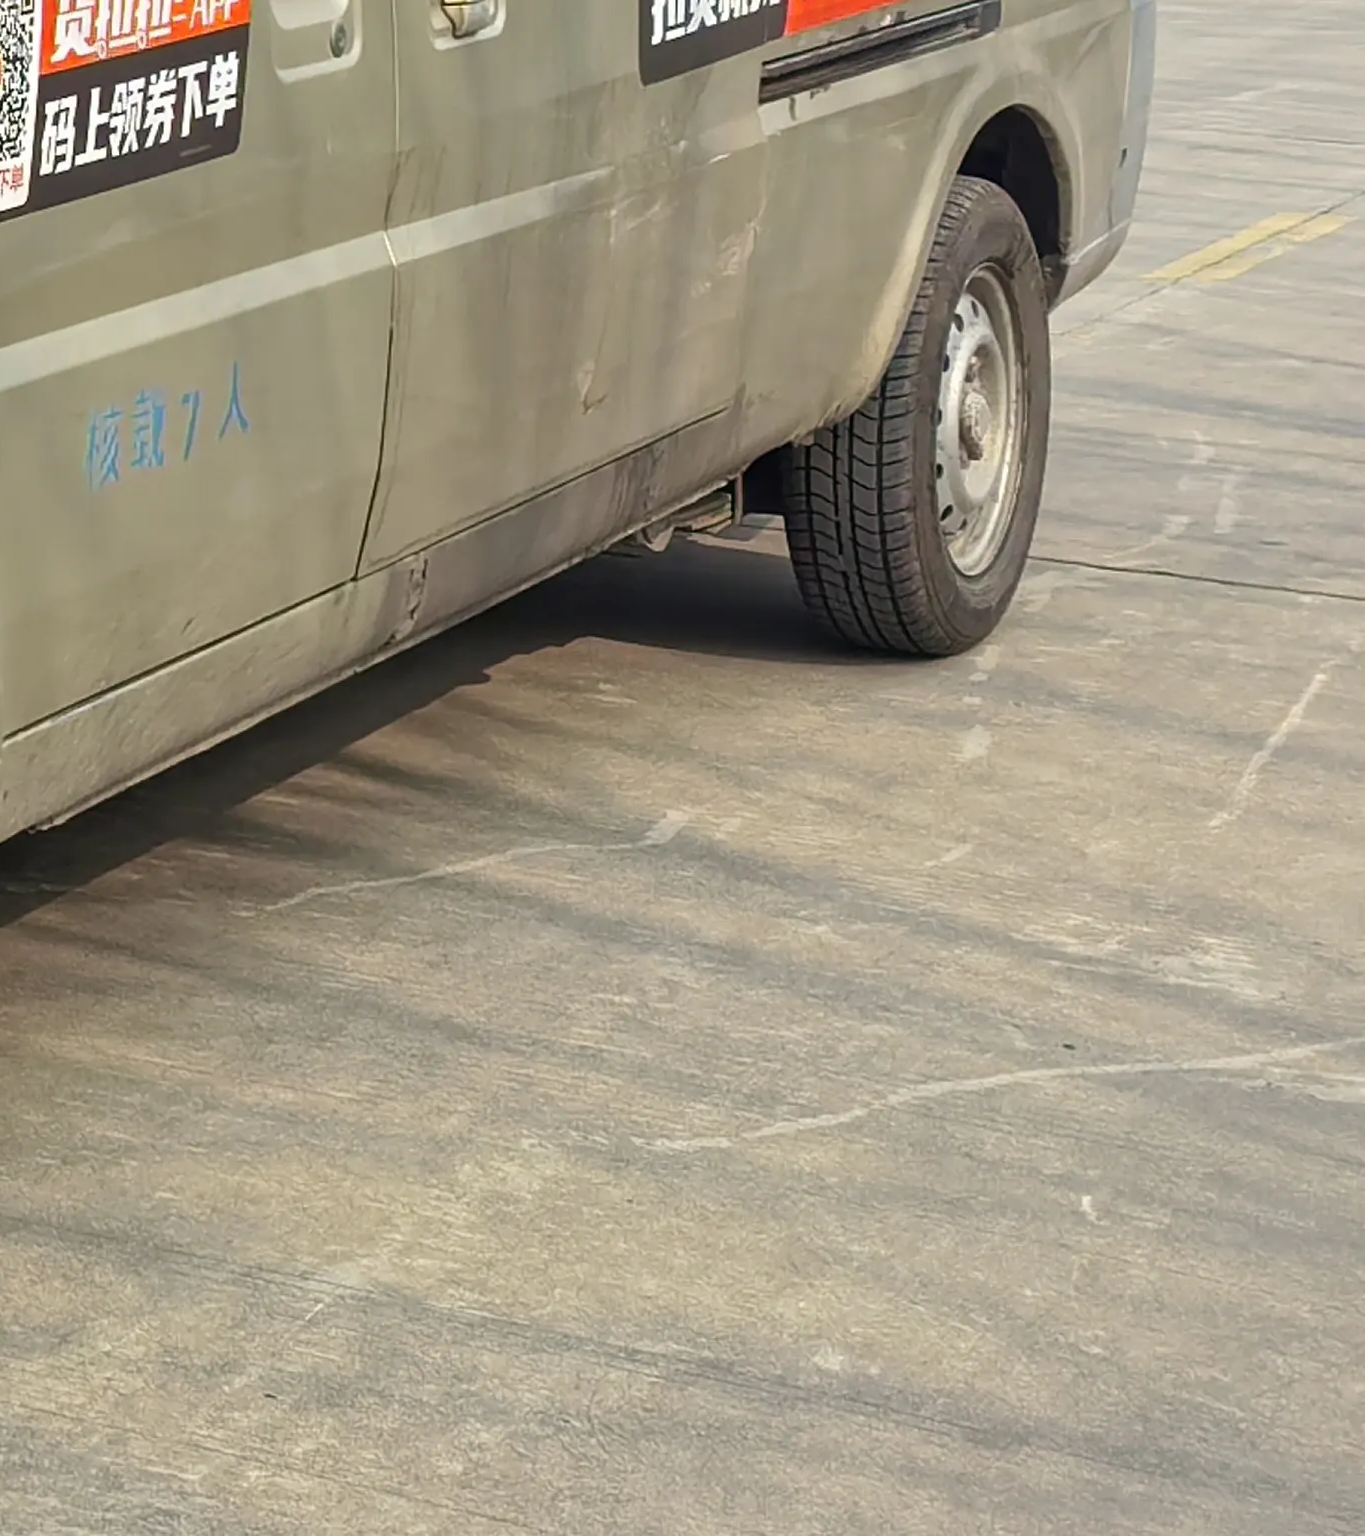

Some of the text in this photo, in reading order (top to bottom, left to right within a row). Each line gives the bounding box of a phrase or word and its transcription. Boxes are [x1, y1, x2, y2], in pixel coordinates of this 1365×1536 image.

[39, 51, 240, 177] 码上领券下单
